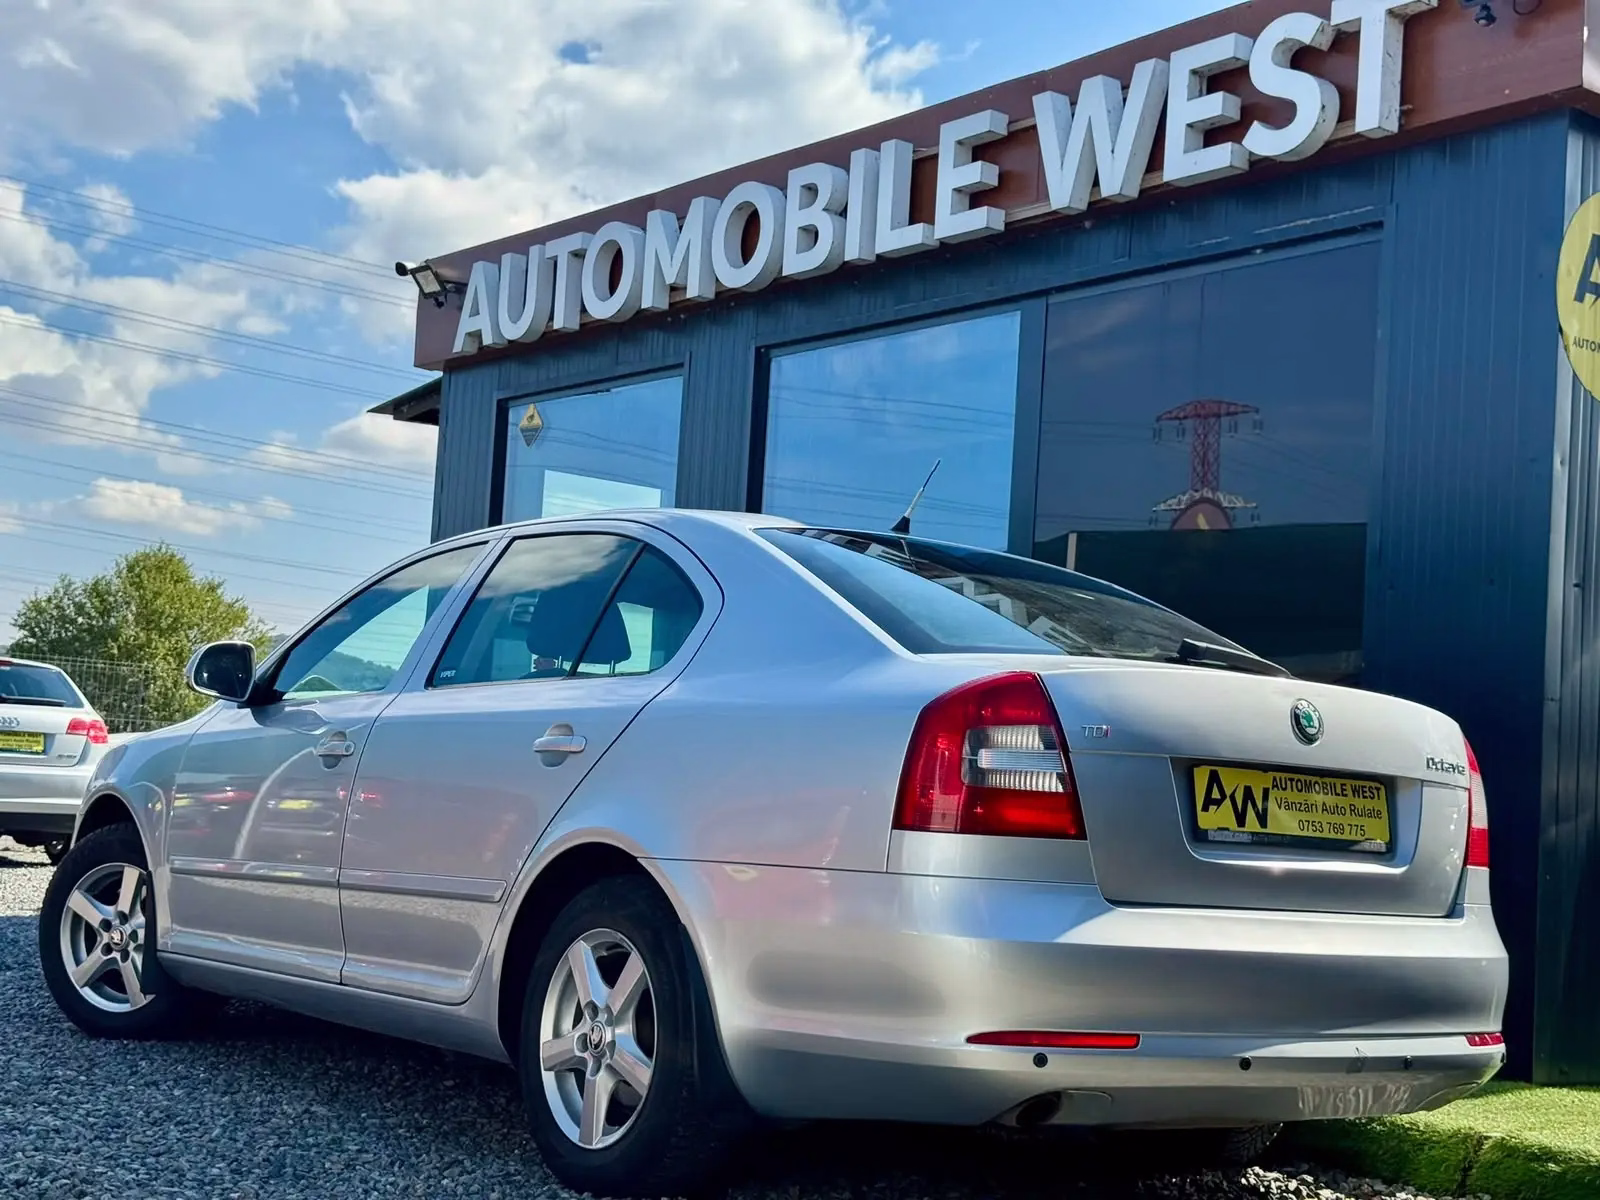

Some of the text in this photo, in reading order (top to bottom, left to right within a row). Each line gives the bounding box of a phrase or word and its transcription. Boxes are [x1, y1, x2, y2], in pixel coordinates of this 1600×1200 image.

[452, 0, 1439, 354] AUTOMOBILE WEST
[1271, 776, 1382, 801] AUTOMOBILE WEST
[1321, 803, 1347, 816] Auto
[1349, 805, 1383, 820] Rulate
[1298, 819, 1366, 838] 0753 769 775
